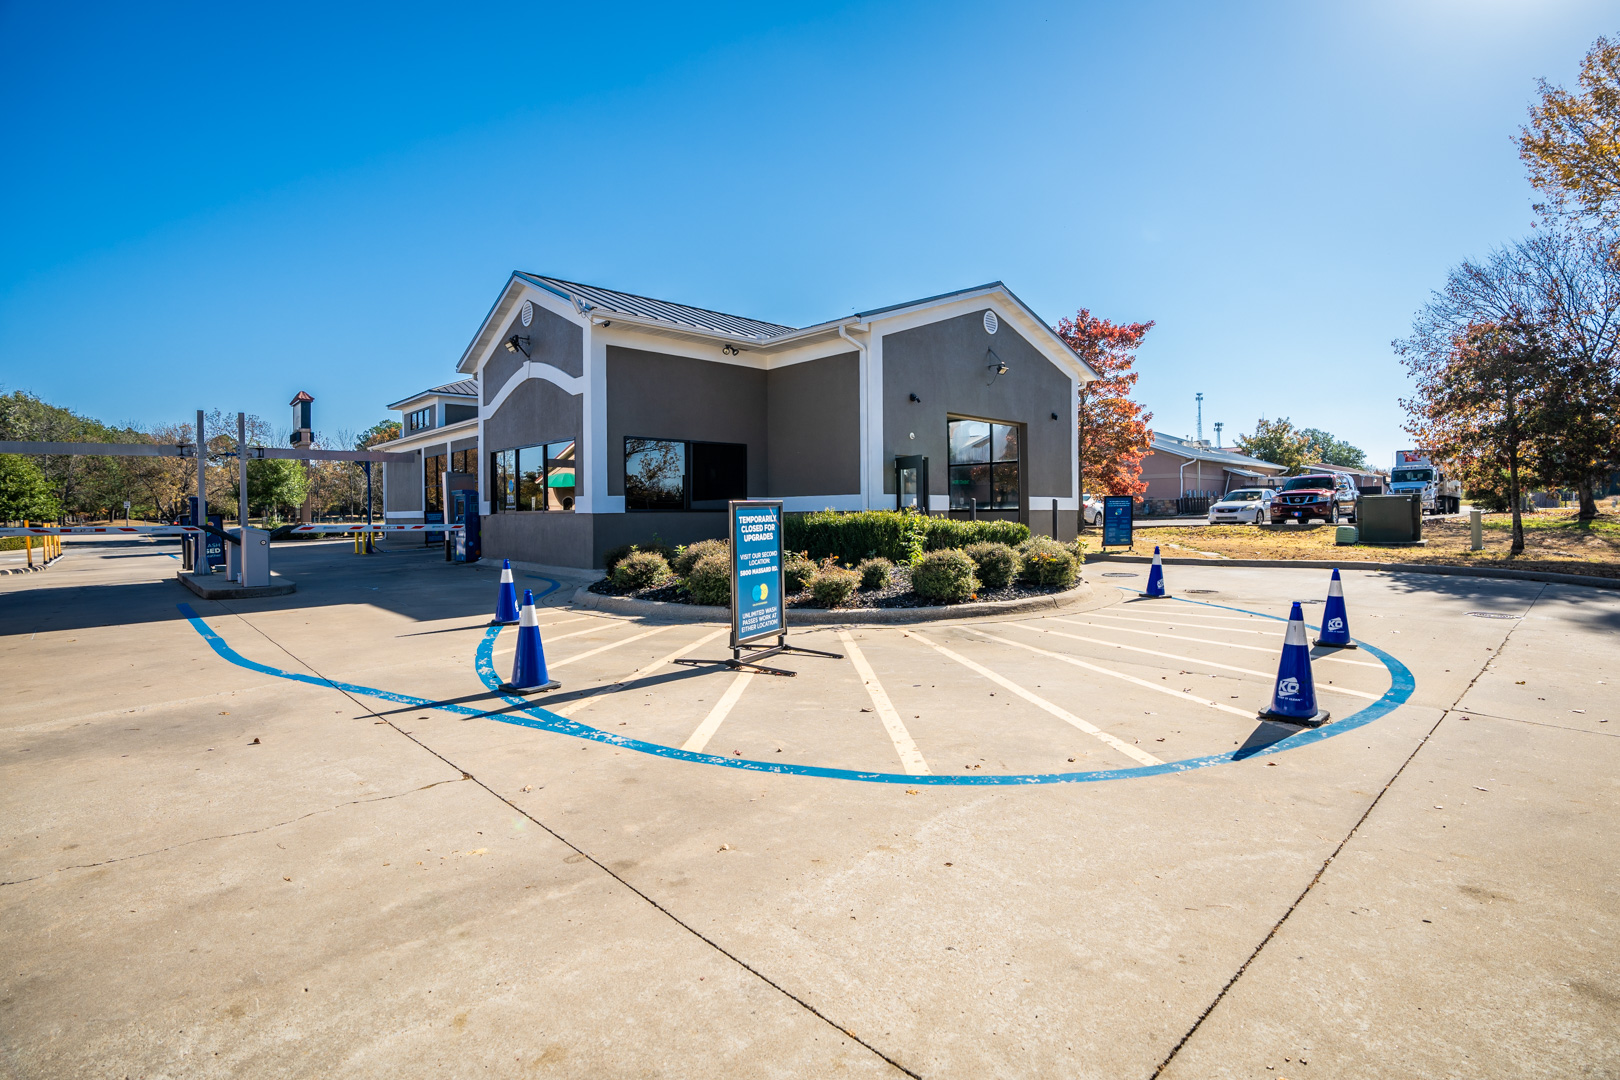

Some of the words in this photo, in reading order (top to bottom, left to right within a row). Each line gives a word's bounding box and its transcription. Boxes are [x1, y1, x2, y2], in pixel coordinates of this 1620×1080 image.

[738, 514, 776, 524] TEMPORARILY
[741, 524, 763, 533] CLOSED
[744, 532, 774, 542] UPGRADES
[742, 609, 764, 619] UNLIMITED
[742, 617, 758, 626] PASSES
[742, 624, 756, 633] EITHER
